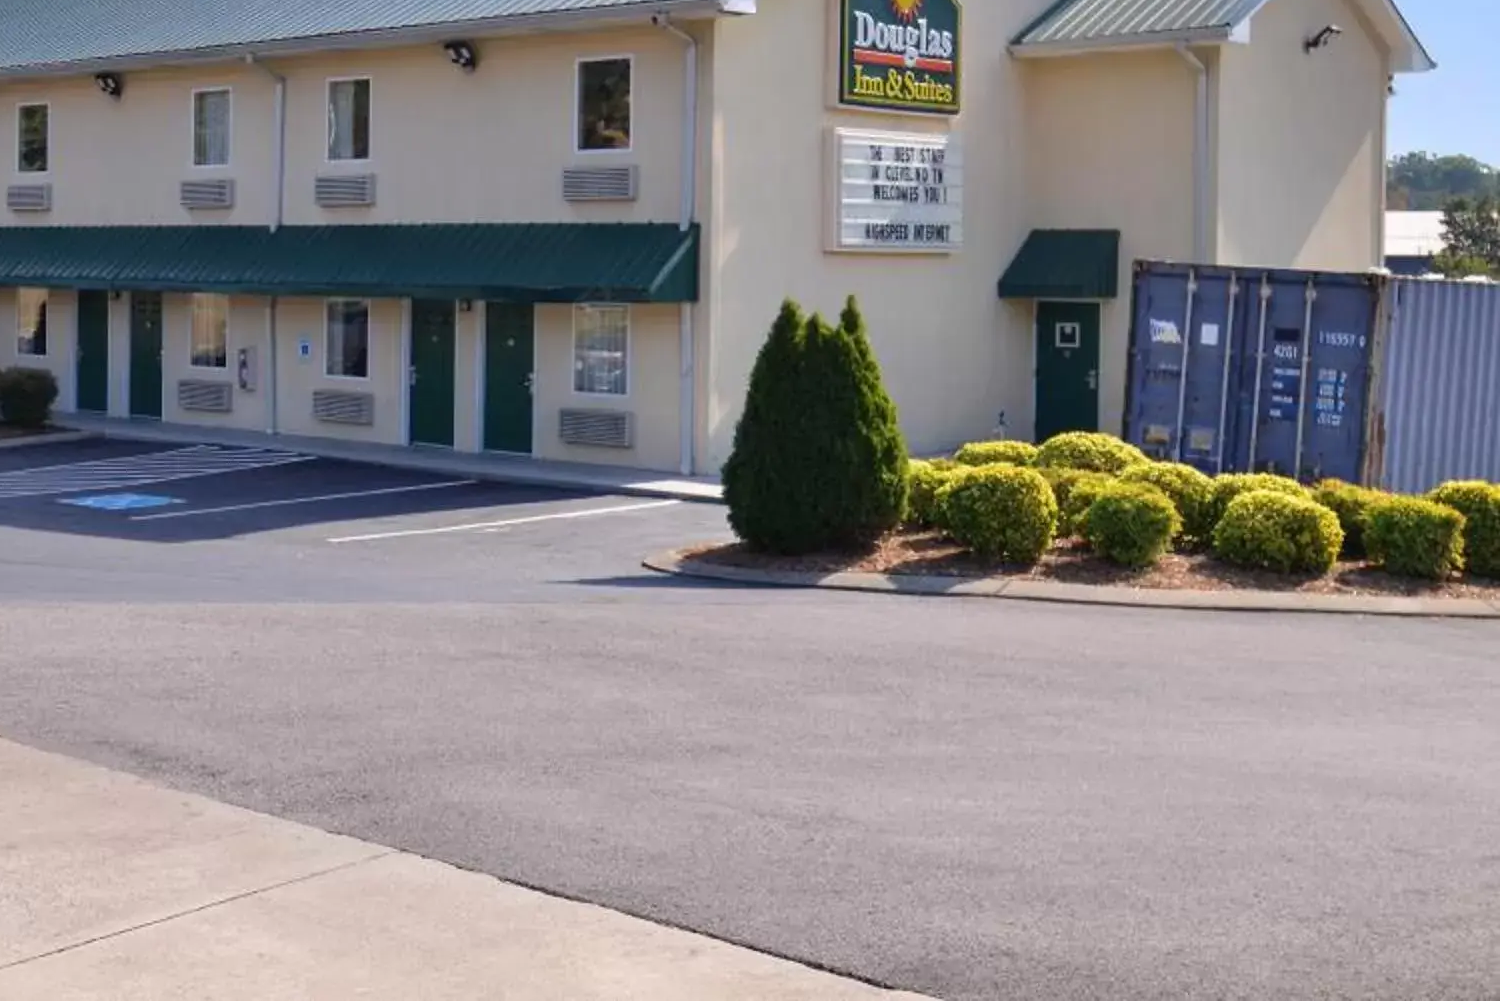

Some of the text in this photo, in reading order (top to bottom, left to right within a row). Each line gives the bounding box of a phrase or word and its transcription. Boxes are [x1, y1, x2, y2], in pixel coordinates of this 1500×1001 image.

[853, 10, 953, 68] Douglas
[853, 64, 953, 102] Inn & Suites
[895, 146, 915, 163] BEST
[873, 185, 919, 203] WELCOMES
